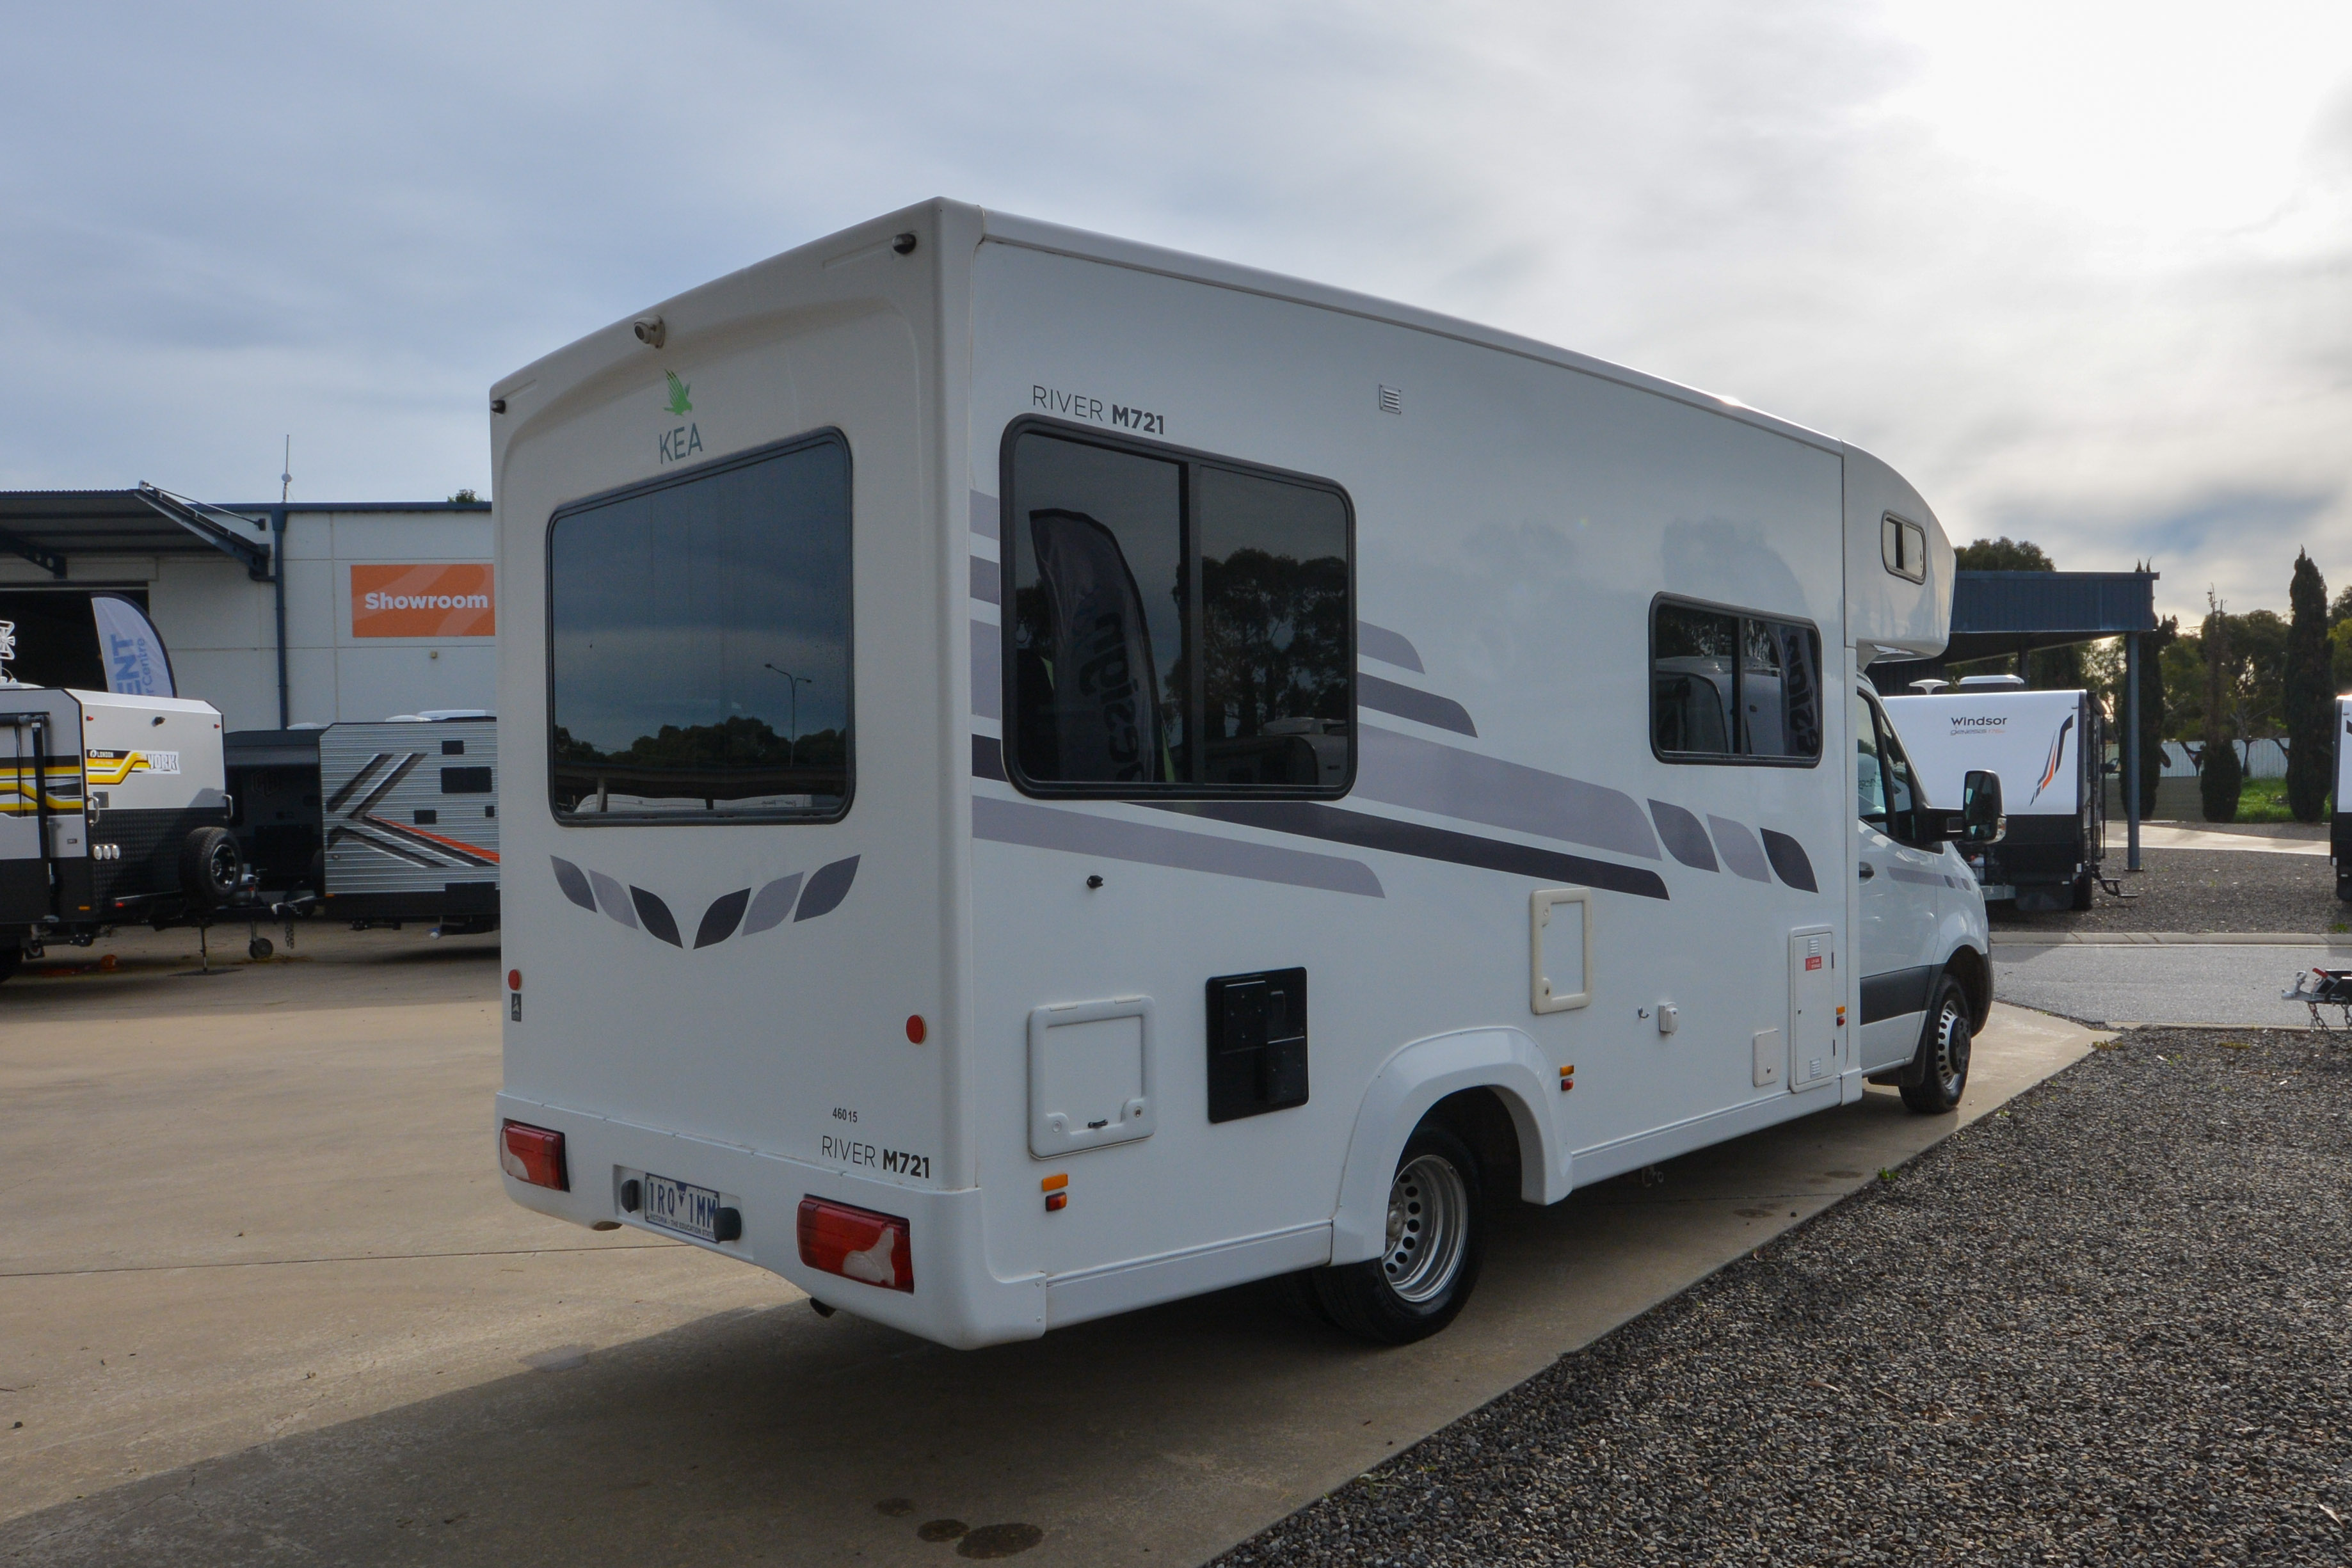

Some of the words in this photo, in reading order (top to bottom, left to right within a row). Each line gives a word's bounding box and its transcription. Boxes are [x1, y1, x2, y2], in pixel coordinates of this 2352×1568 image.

[1033, 385, 1103, 422] RIVER
[1112, 404, 1164, 435] M721
[659, 422, 703, 465] KEA
[365, 593, 488, 609] Showroom
[138, 638, 153, 685] Centre
[1951, 716, 2008, 726] Windsor
[147, 754, 177, 770] YORK
[832, 1107, 858, 1123] 46015
[822, 1135, 876, 1168] RIVER
[883, 1149, 929, 1179] M721
[679, 1222, 701, 1234] EDUCATION
